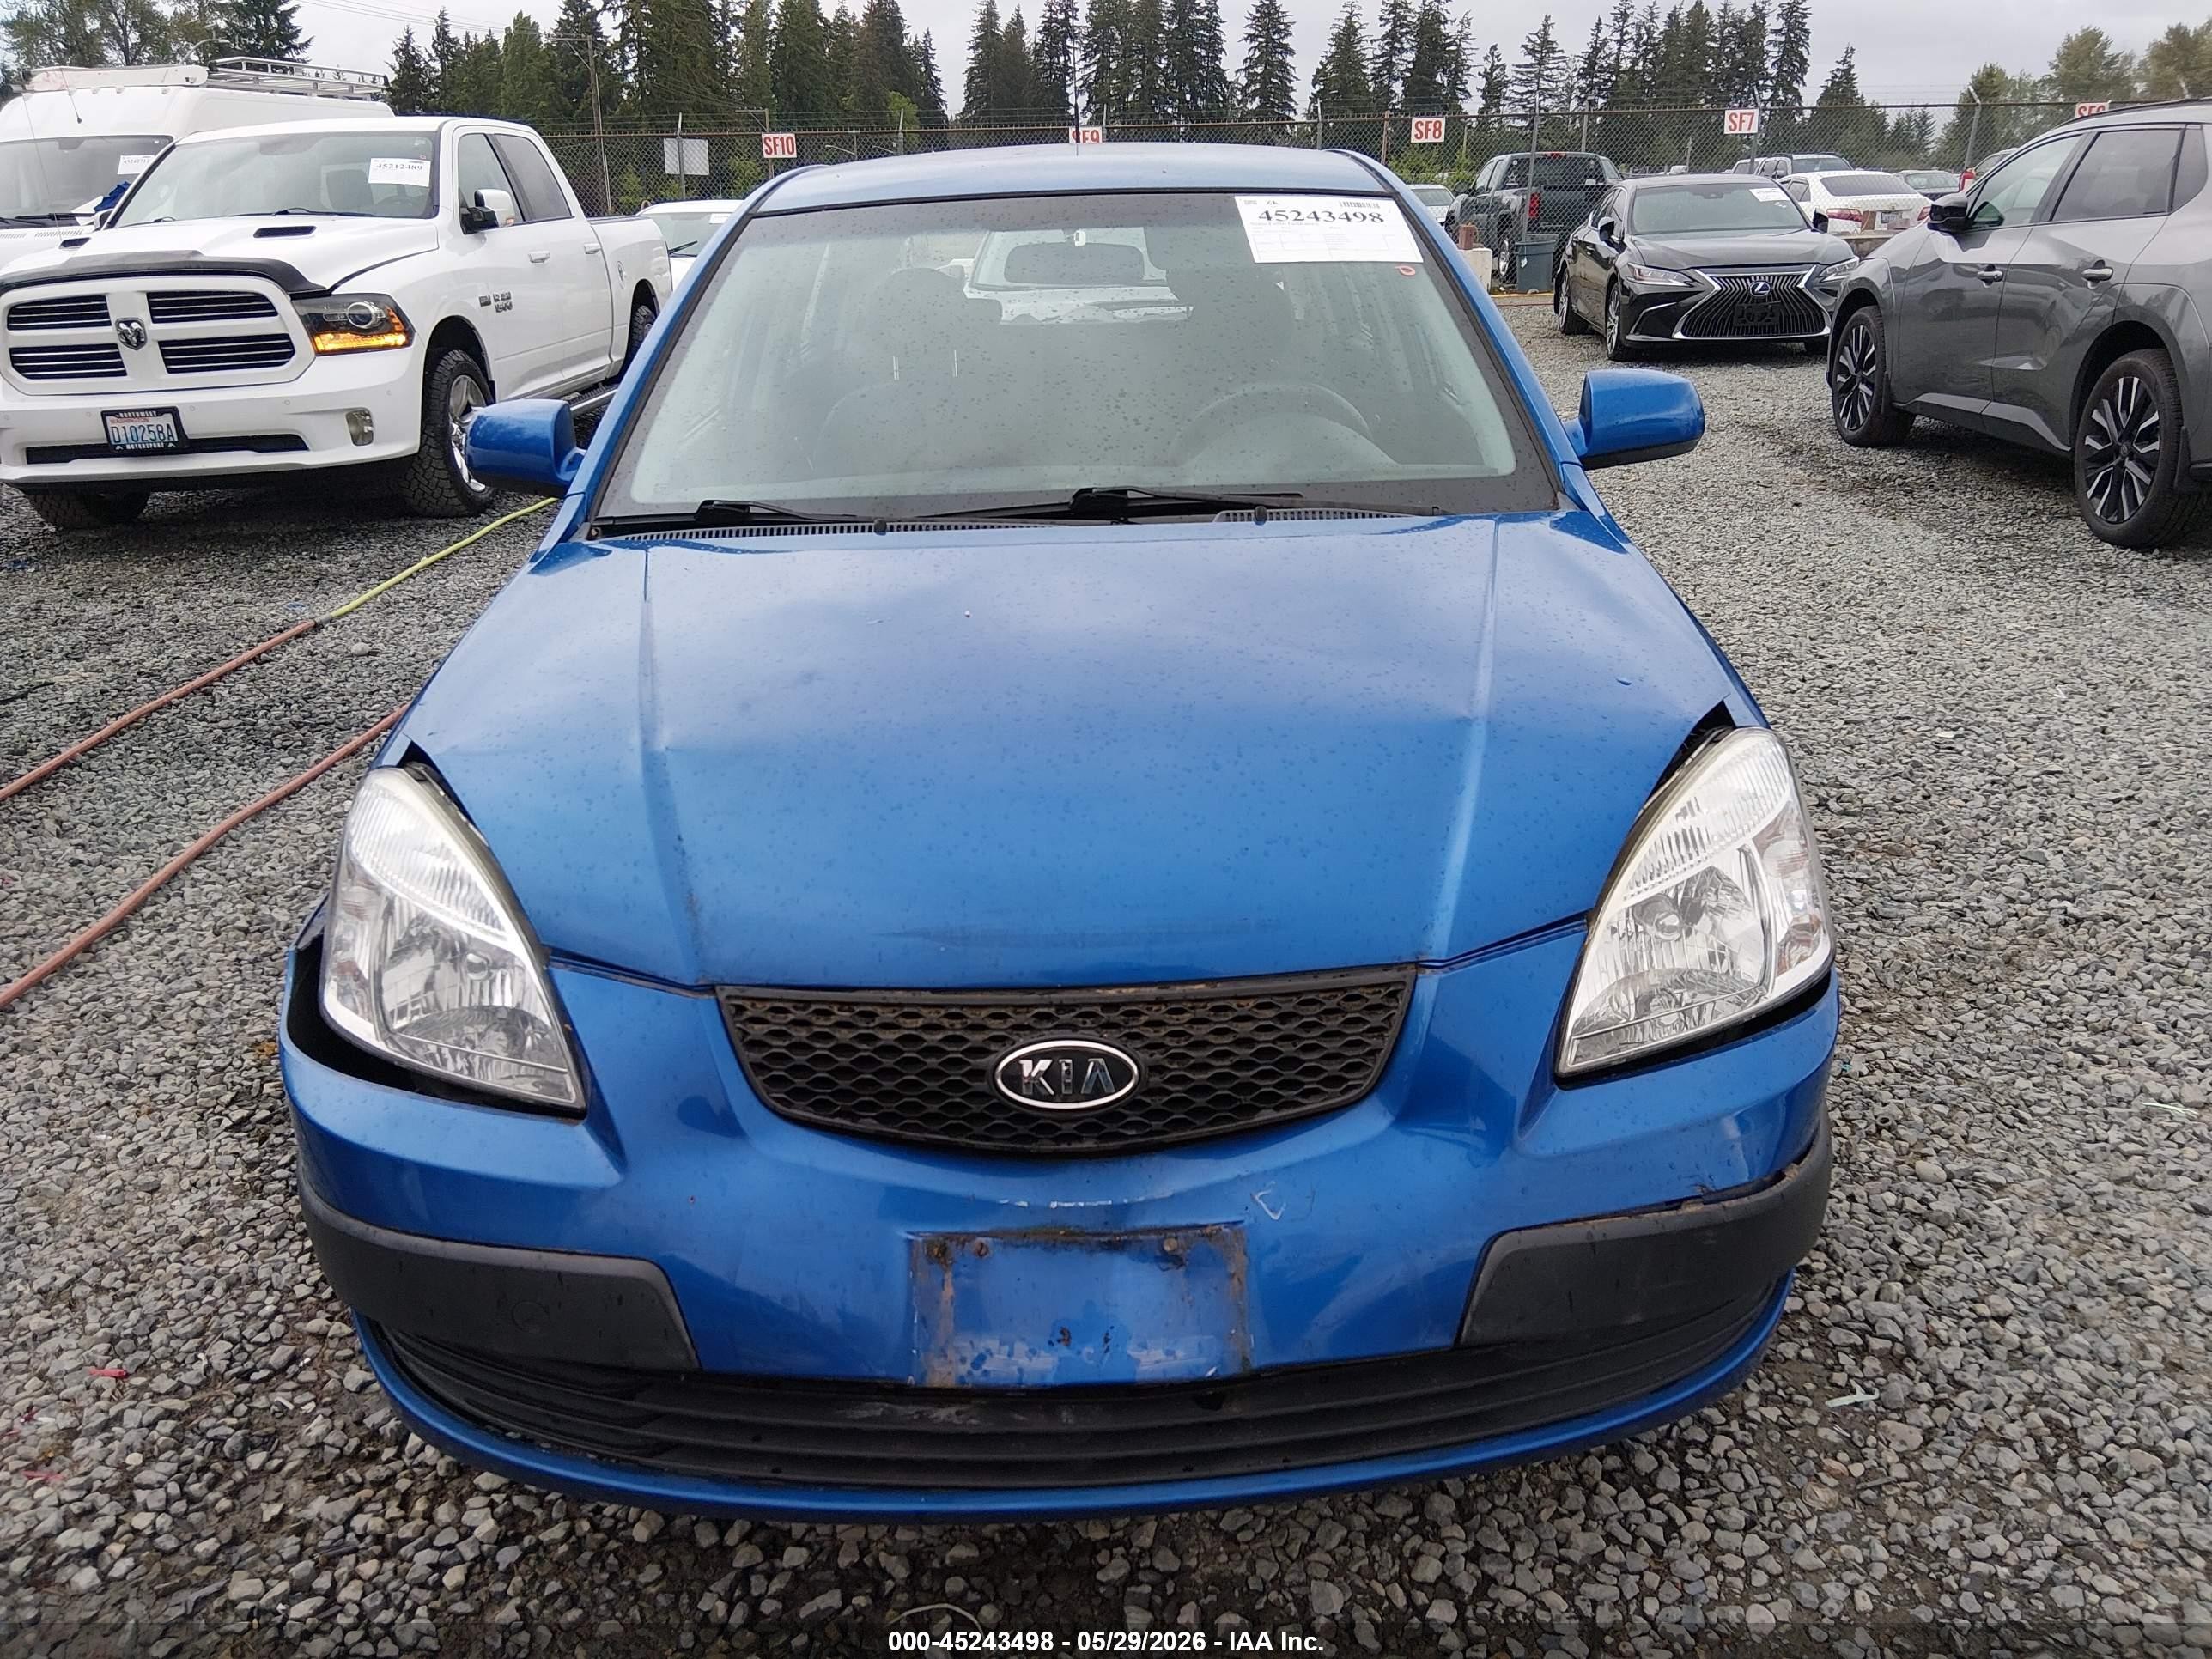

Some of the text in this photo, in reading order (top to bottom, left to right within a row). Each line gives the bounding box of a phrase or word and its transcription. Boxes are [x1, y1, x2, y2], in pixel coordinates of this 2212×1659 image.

[1414, 120, 1442, 140] SF8
[1728, 112, 1754, 131] SF7
[763, 136, 794, 155] SF10
[1258, 210, 1385, 224] 45243498
[111, 423, 175, 443] D10258A
[1019, 1058, 1116, 1096] KIA
